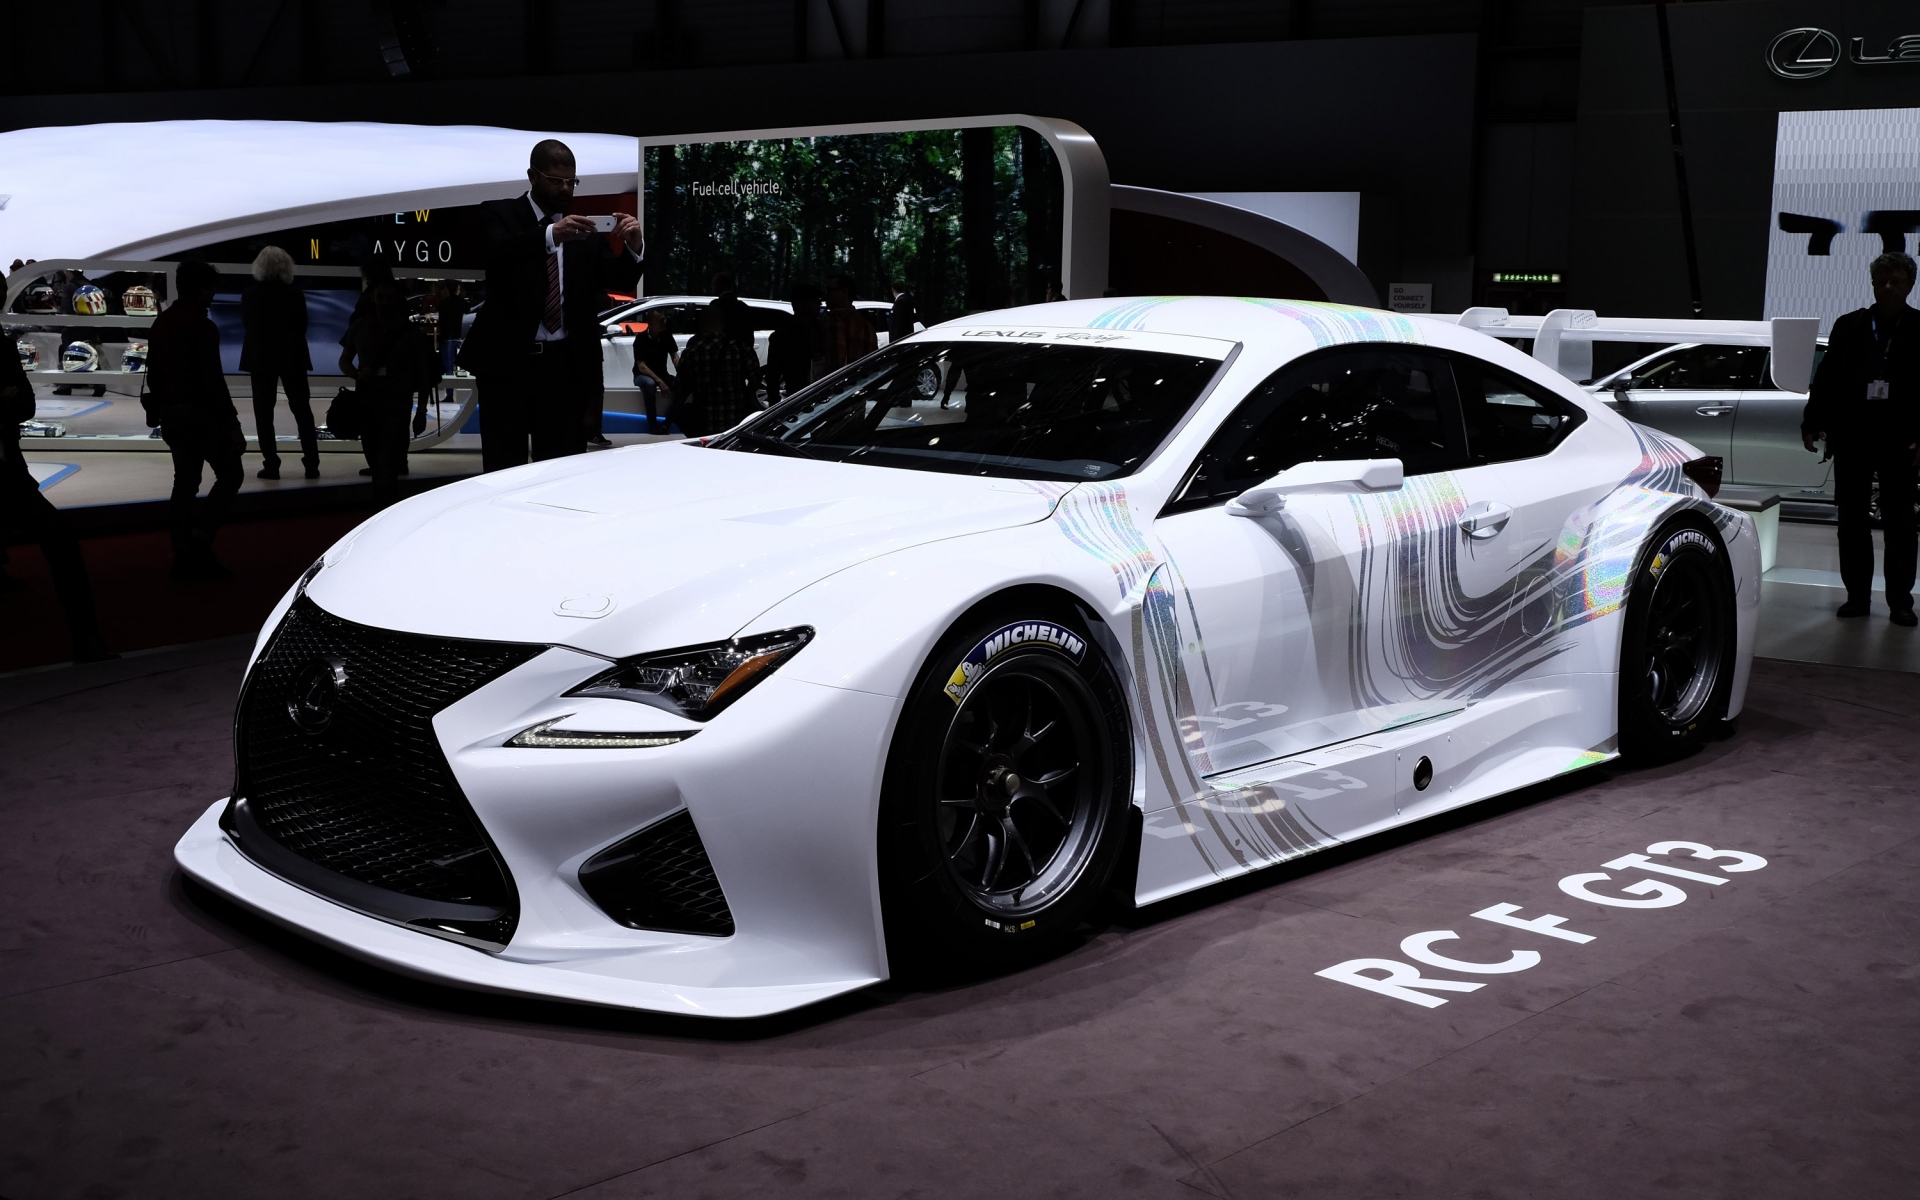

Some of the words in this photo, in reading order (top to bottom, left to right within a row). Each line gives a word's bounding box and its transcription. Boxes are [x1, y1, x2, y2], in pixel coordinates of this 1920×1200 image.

[692, 181, 716, 196] Fuel
[718, 180, 738, 195] cell
[740, 179, 783, 196] vehicle,
[961, 330, 1046, 339] LEXUS
[1669, 531, 1715, 554] MICHELIN
[984, 624, 1083, 661] MICHELIN
[1313, 930, 1542, 1009] RC
[1469, 901, 1597, 945] F
[1557, 840, 1768, 909] GT3
